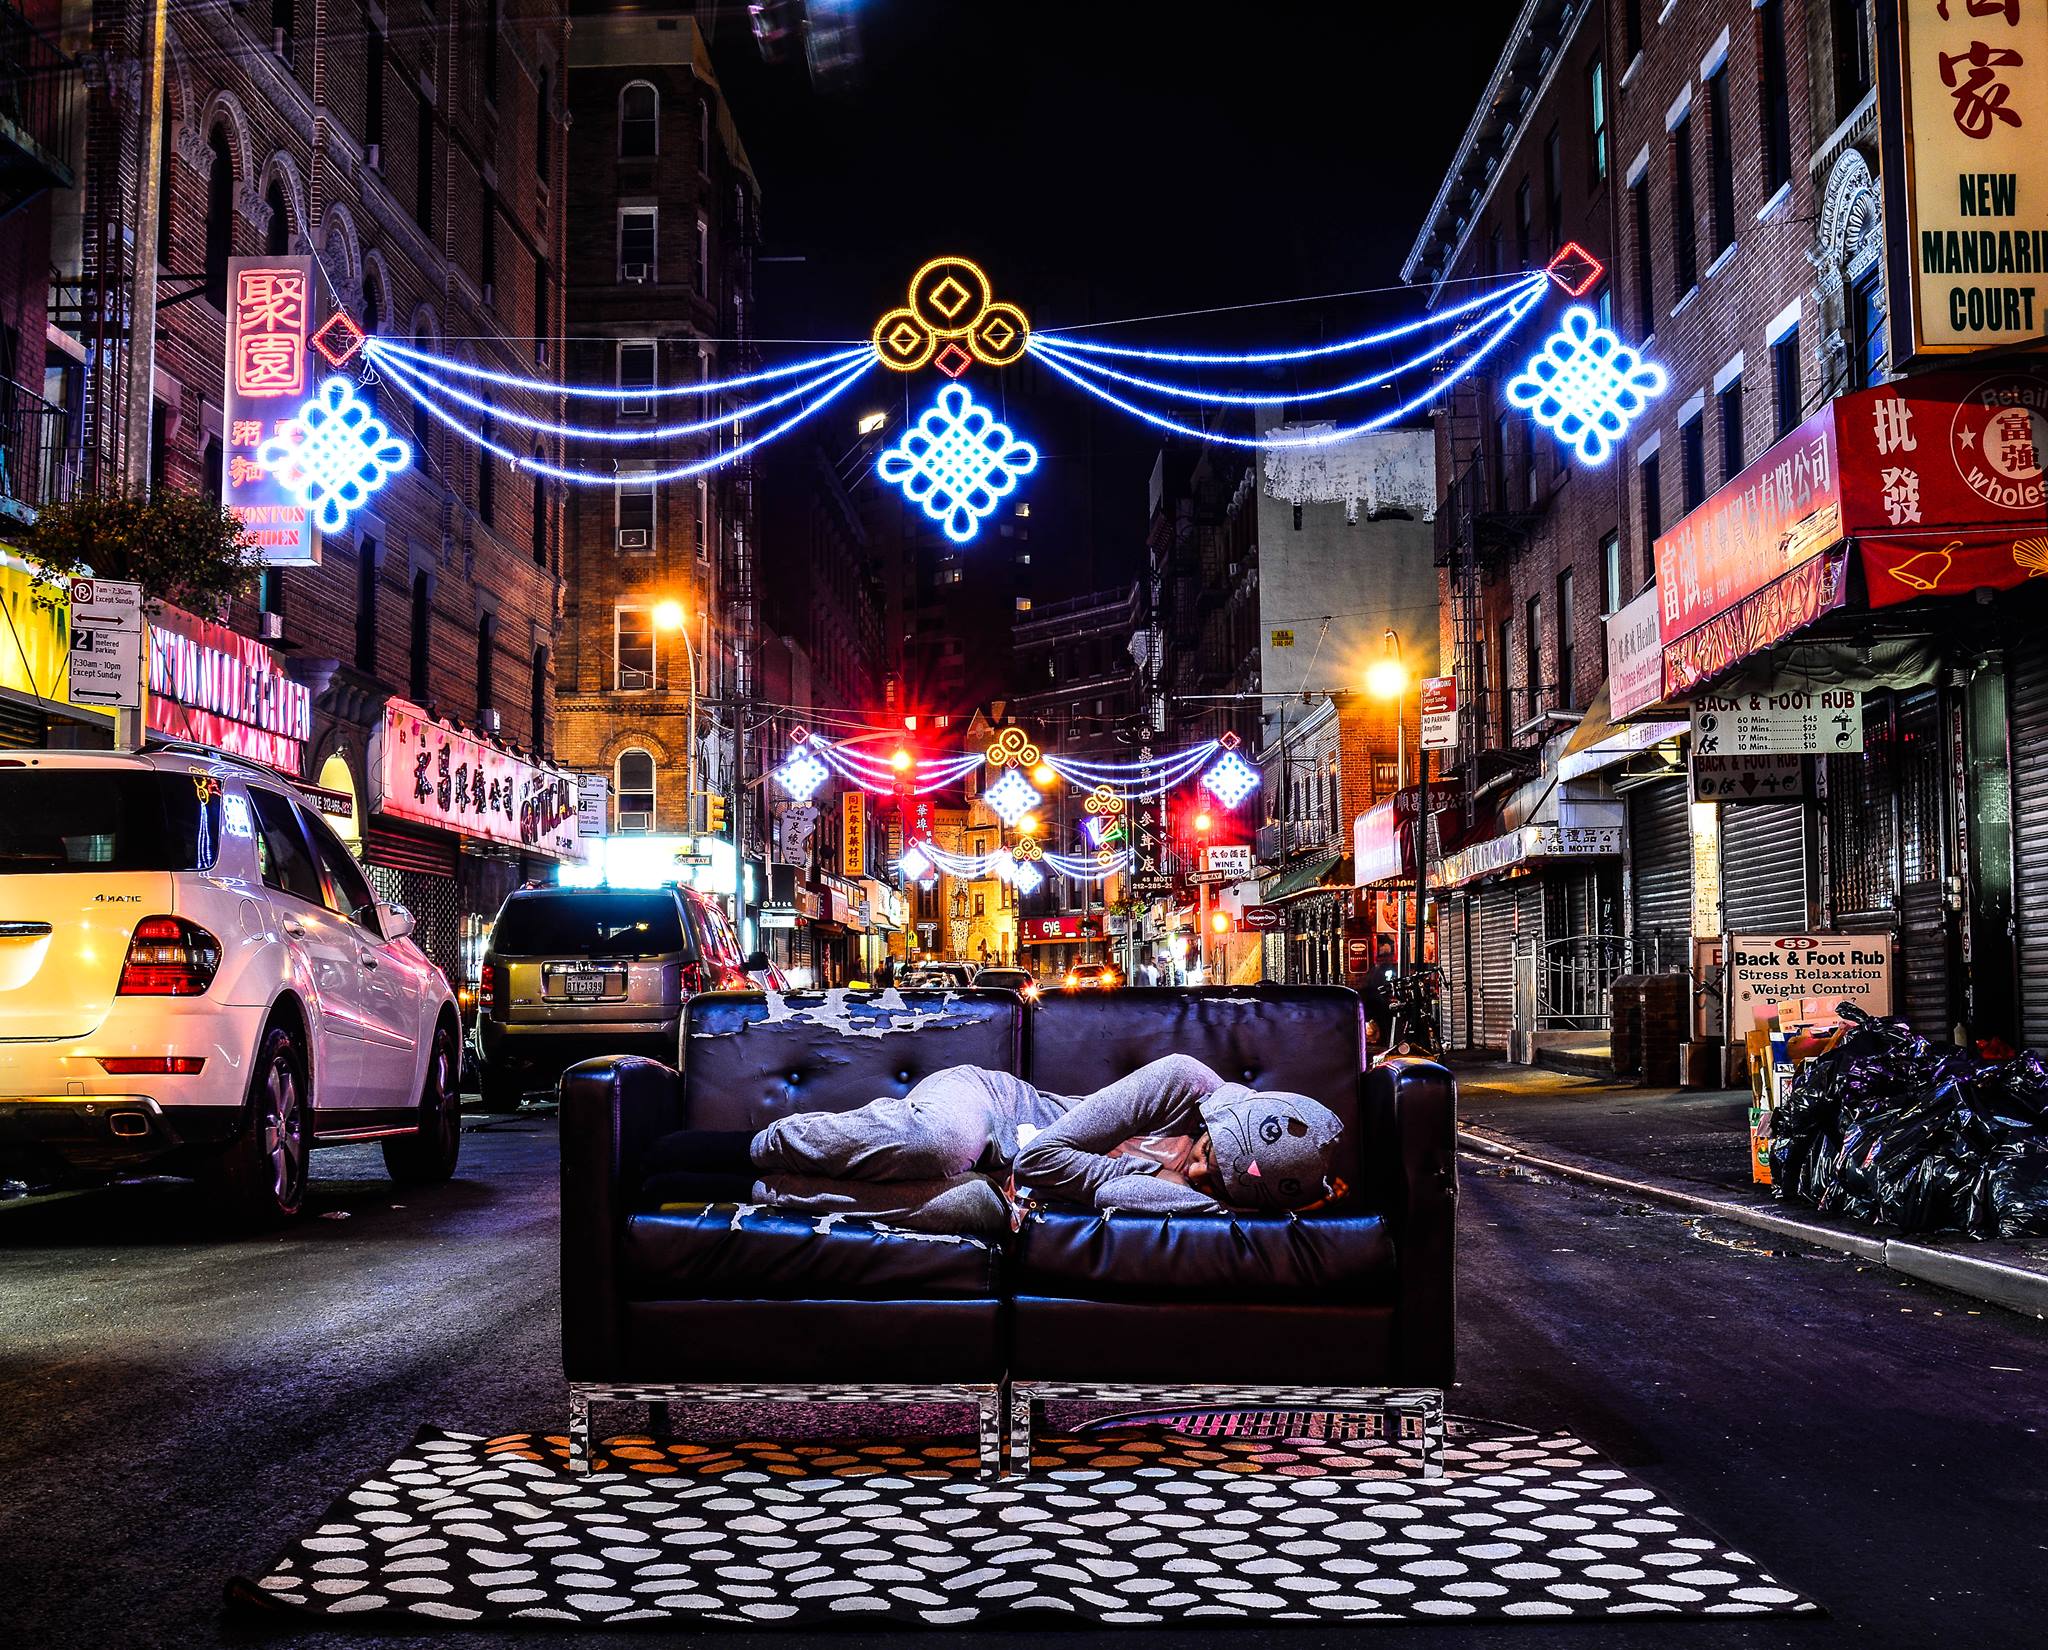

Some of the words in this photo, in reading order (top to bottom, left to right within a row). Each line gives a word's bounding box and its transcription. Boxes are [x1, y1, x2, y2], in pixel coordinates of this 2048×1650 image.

[1959, 173, 2016, 216] NEW
[1950, 286, 2035, 331] COURT
[239, 275, 303, 388] 聚園
[1997, 413, 2043, 472] 富強
[1872, 398, 1923, 526] 批發
[95, 596, 114, 605] Except
[115, 597, 135, 607] Sunday
[75, 630, 88, 649] 2
[95, 631, 109, 640] hour
[95, 639, 119, 648] metered
[95, 646, 117, 656] parking
[73, 658, 98, 669] 7:30am
[104, 660, 121, 671] 10pm
[72, 668, 96, 678] Except
[97, 670, 121, 682] Sunday
[1695, 696, 1742, 712] BACK
[1750, 692, 1761, 711] &
[1769, 692, 1813, 710] FOOT
[1822, 691, 1856, 709] RUB
[1431, 714, 1451, 723] PARKING
[1737, 716, 1748, 724] 60
[1803, 715, 1817, 723] $45
[1424, 724, 1442, 733] Anytime
[1737, 725, 1748, 733] 30
[1803, 724, 1817, 732] $25
[1737, 734, 1746, 742] 17
[1803, 733, 1817, 741] $15
[1737, 743, 1746, 751] 10
[1803, 741, 1817, 749] $10
[1700, 757, 1727, 772] BACK
[1745, 756, 1772, 770] FOOT
[1777, 754, 1799, 768] RUB
[1042, 920, 1060, 938] eye
[1783, 939, 1810, 949] 59
[1735, 951, 1779, 966] Back
[1786, 951, 1800, 966] &
[1806, 951, 1846, 966] Foot
[1851, 950, 1885, 965] Rub
[1739, 969, 1788, 980] Stress
[1795, 968, 1882, 980] Relaxation
[1752, 983, 1806, 998] Weight
[1812, 983, 1870, 995] Control
